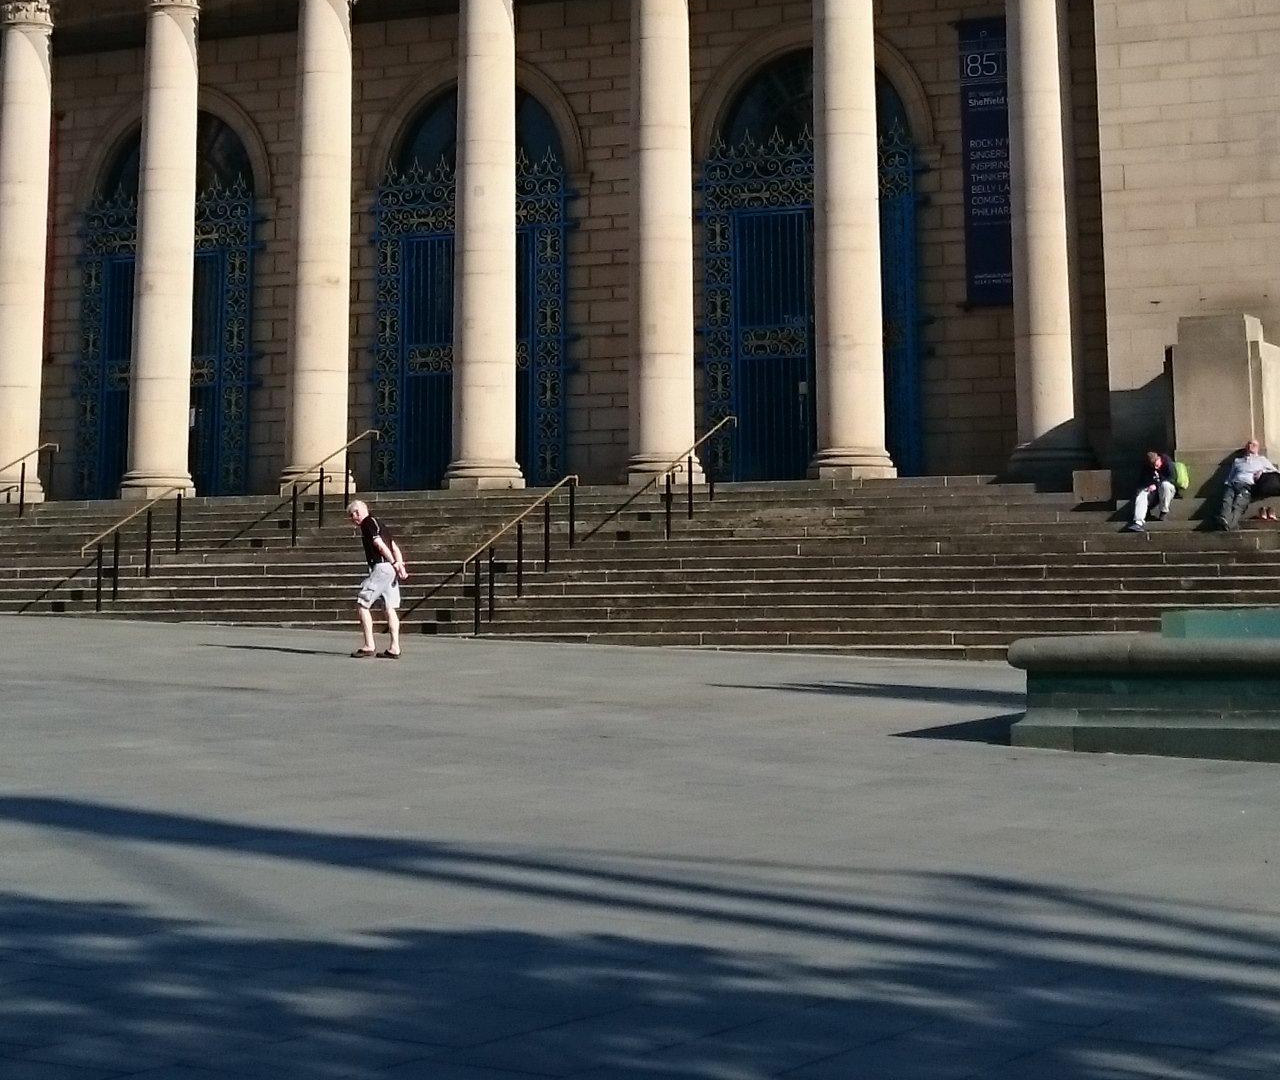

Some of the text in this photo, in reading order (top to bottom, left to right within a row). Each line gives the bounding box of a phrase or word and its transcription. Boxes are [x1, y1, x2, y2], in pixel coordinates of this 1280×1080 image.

[967, 53, 997, 77] 85
[968, 96, 1004, 106] Sheffield
[970, 139, 994, 148] ROCK
[970, 149, 1007, 160] SINGERS
[971, 171, 1009, 182] THINKER
[971, 184, 997, 194] BELLY
[971, 195, 1005, 205] COMICS
[971, 206, 1009, 216] PHILHAR
